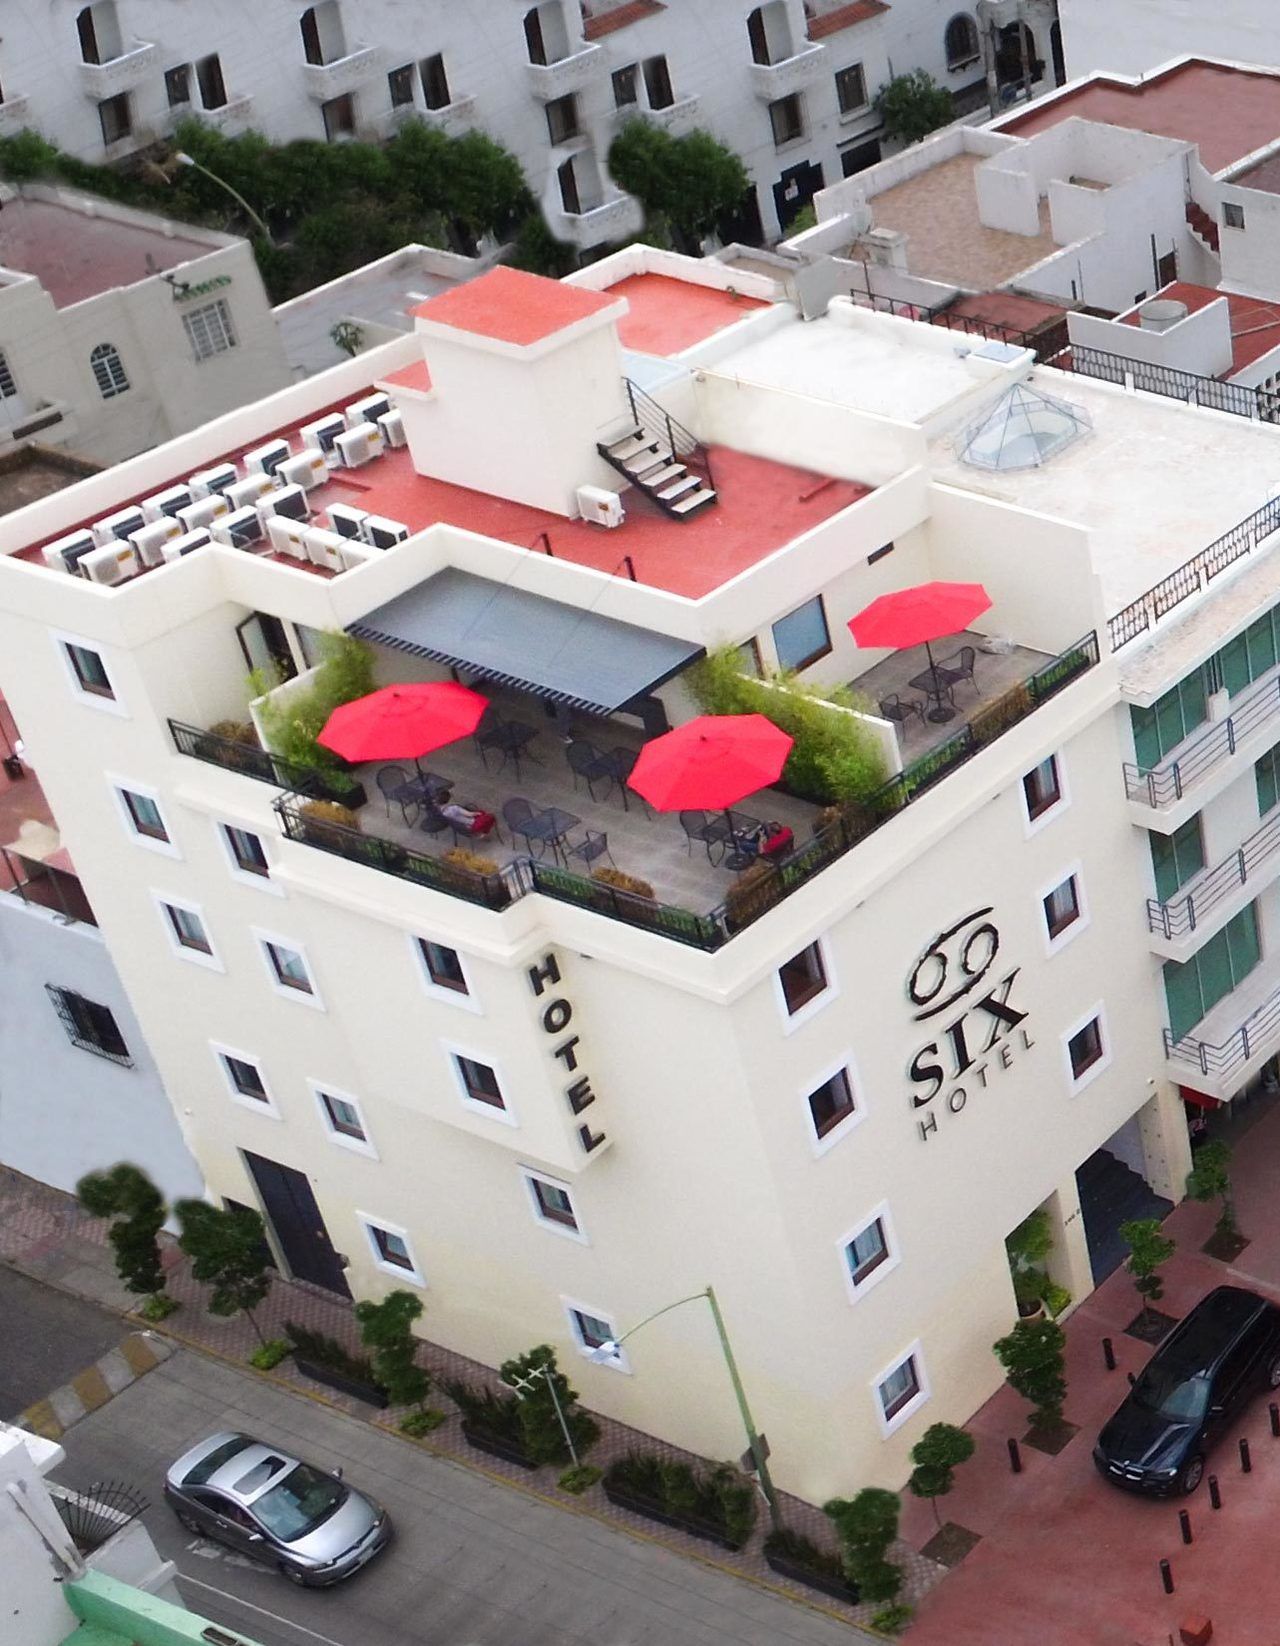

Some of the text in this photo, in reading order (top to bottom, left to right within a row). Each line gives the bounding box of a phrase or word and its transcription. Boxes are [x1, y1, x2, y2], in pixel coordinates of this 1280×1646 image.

[529, 952, 606, 1154] HOTEL
[909, 966, 1030, 1109] SIX
[919, 1030, 1036, 1142] HOTEL
